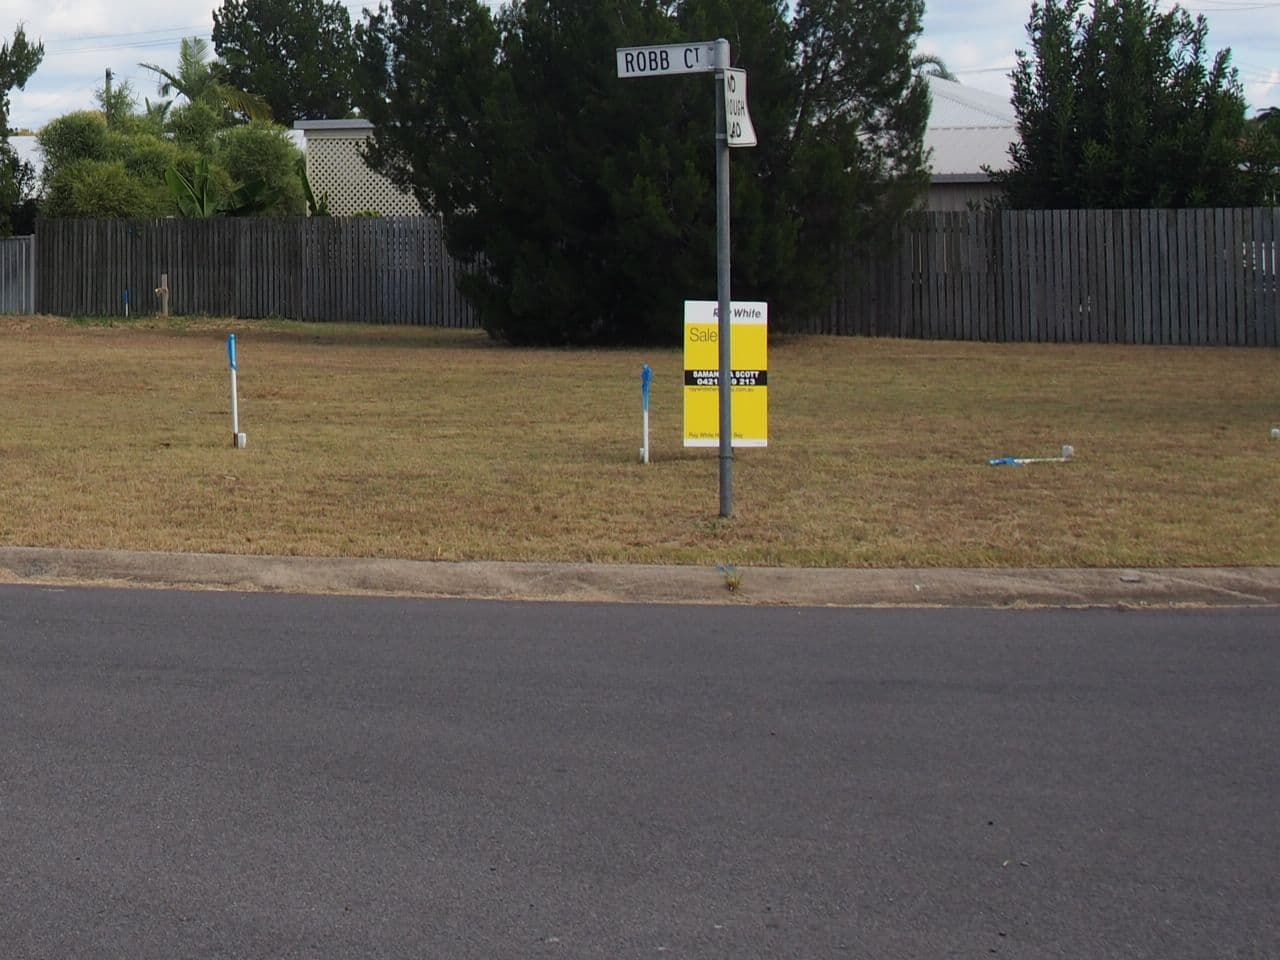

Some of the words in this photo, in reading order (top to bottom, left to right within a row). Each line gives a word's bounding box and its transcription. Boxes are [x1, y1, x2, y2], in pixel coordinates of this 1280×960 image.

[625, 50, 670, 72] ROBB
[734, 308, 761, 318] White
[689, 327, 718, 343] Sale
[693, 370, 734, 378] SAMANA
